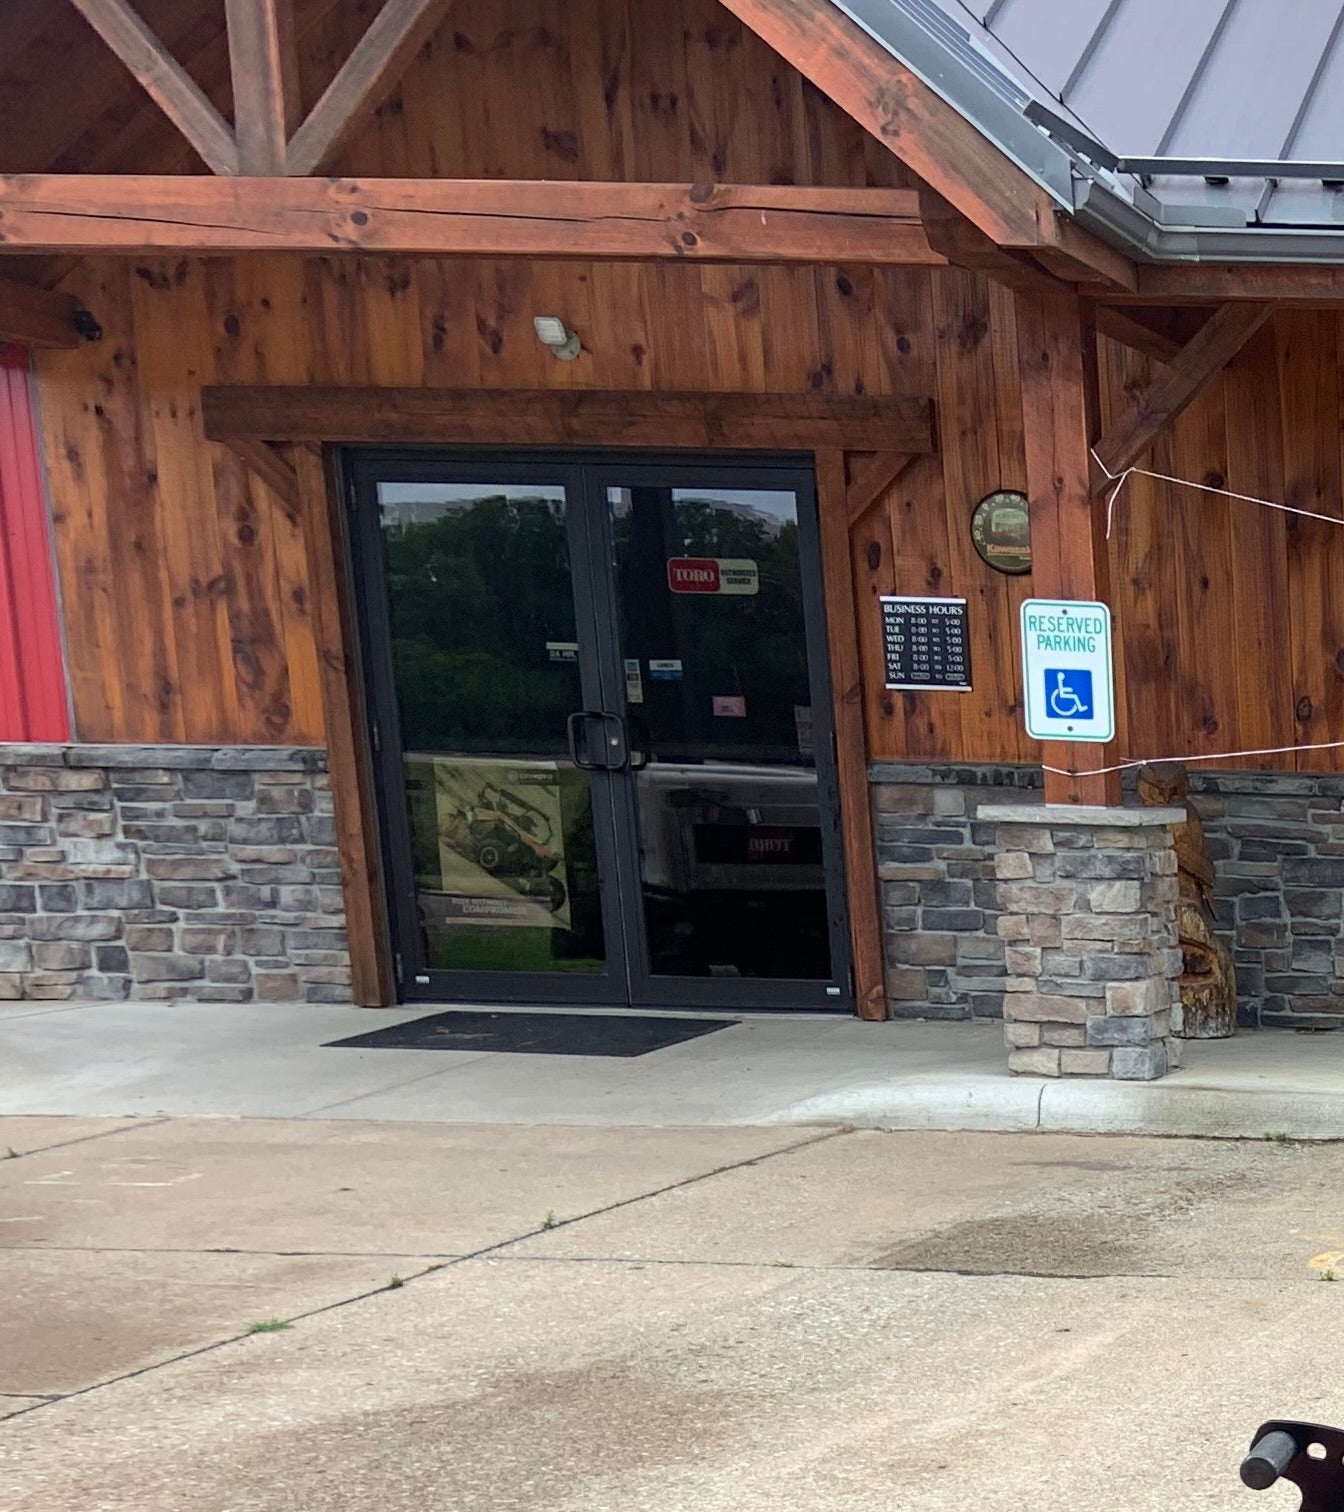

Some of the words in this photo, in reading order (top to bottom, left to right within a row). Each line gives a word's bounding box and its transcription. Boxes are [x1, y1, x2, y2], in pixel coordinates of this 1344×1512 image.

[672, 568, 715, 582] TORO
[884, 604, 926, 614] BUSINESS
[929, 605, 963, 615] HOURS
[1028, 615, 1103, 635] RESERVED
[887, 644, 904, 652] THU
[1037, 634, 1097, 653] PARKING
